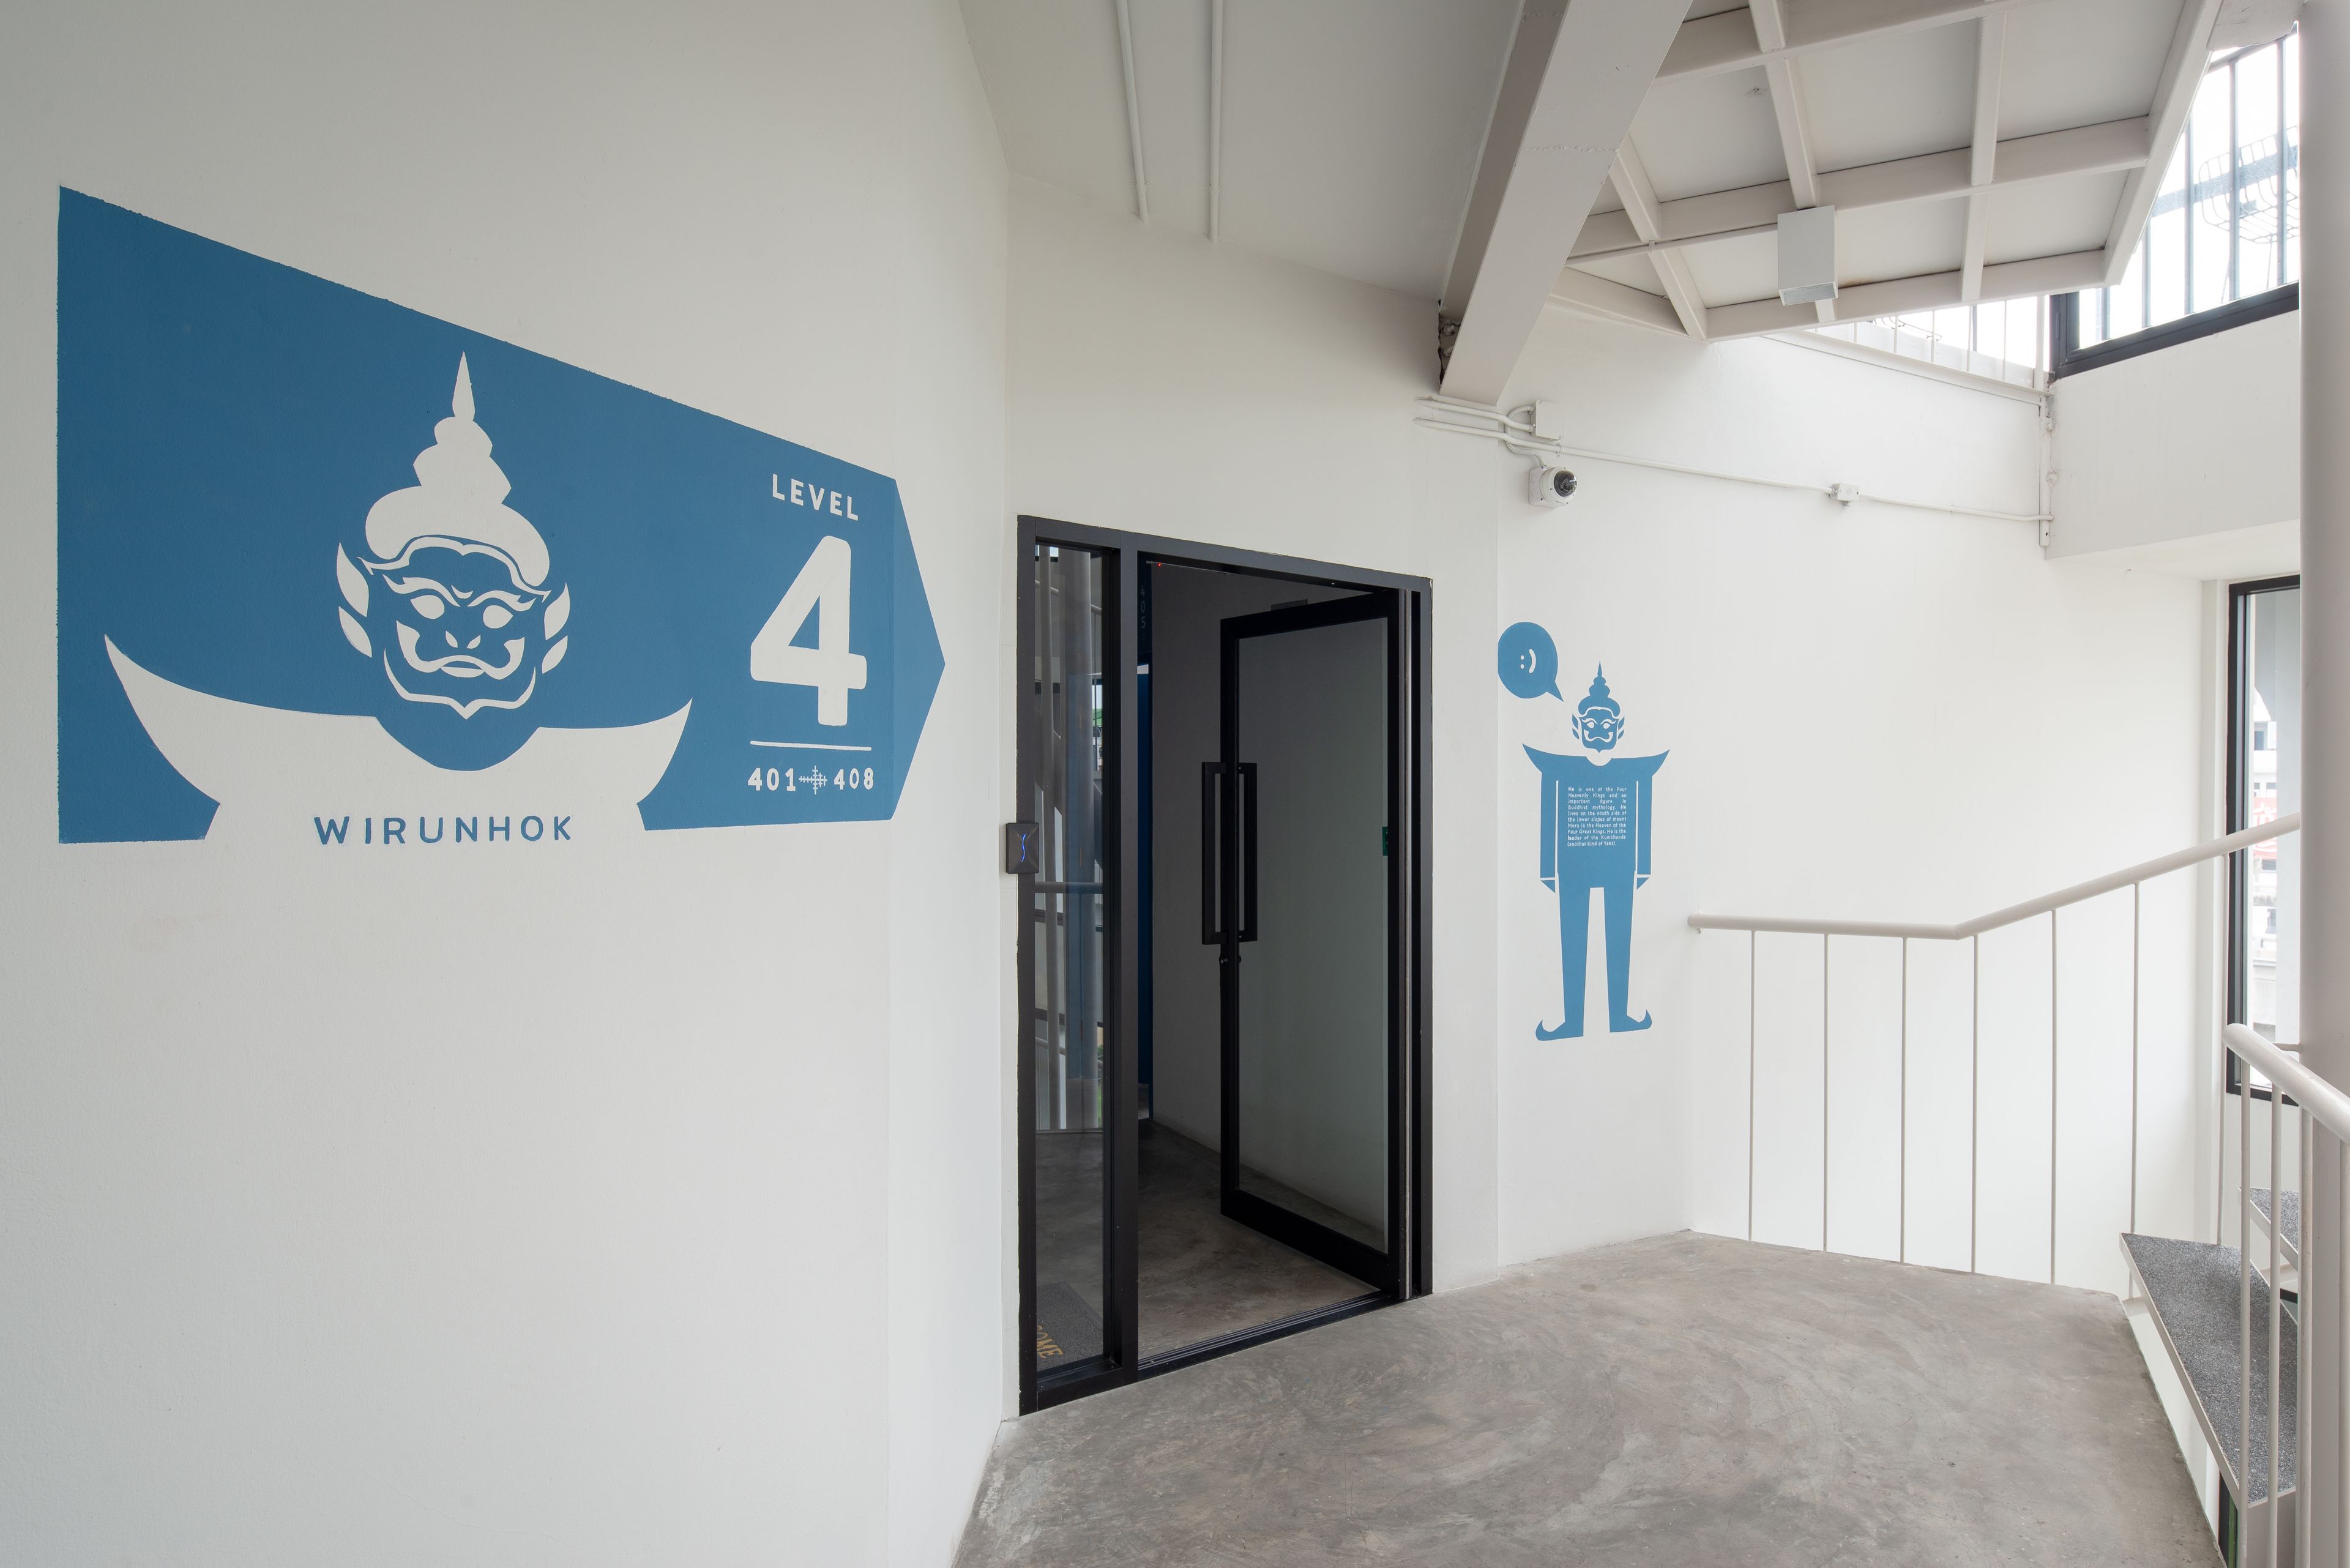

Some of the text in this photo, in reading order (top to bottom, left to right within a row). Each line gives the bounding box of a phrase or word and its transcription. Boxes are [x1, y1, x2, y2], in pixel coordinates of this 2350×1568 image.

[772, 473, 859, 521] LEVEL
[750, 535, 867, 726] 4
[747, 767, 874, 791] 401 408
[314, 815, 571, 845] WIRUNHOK
[1037, 1325, 1064, 1359] OME
